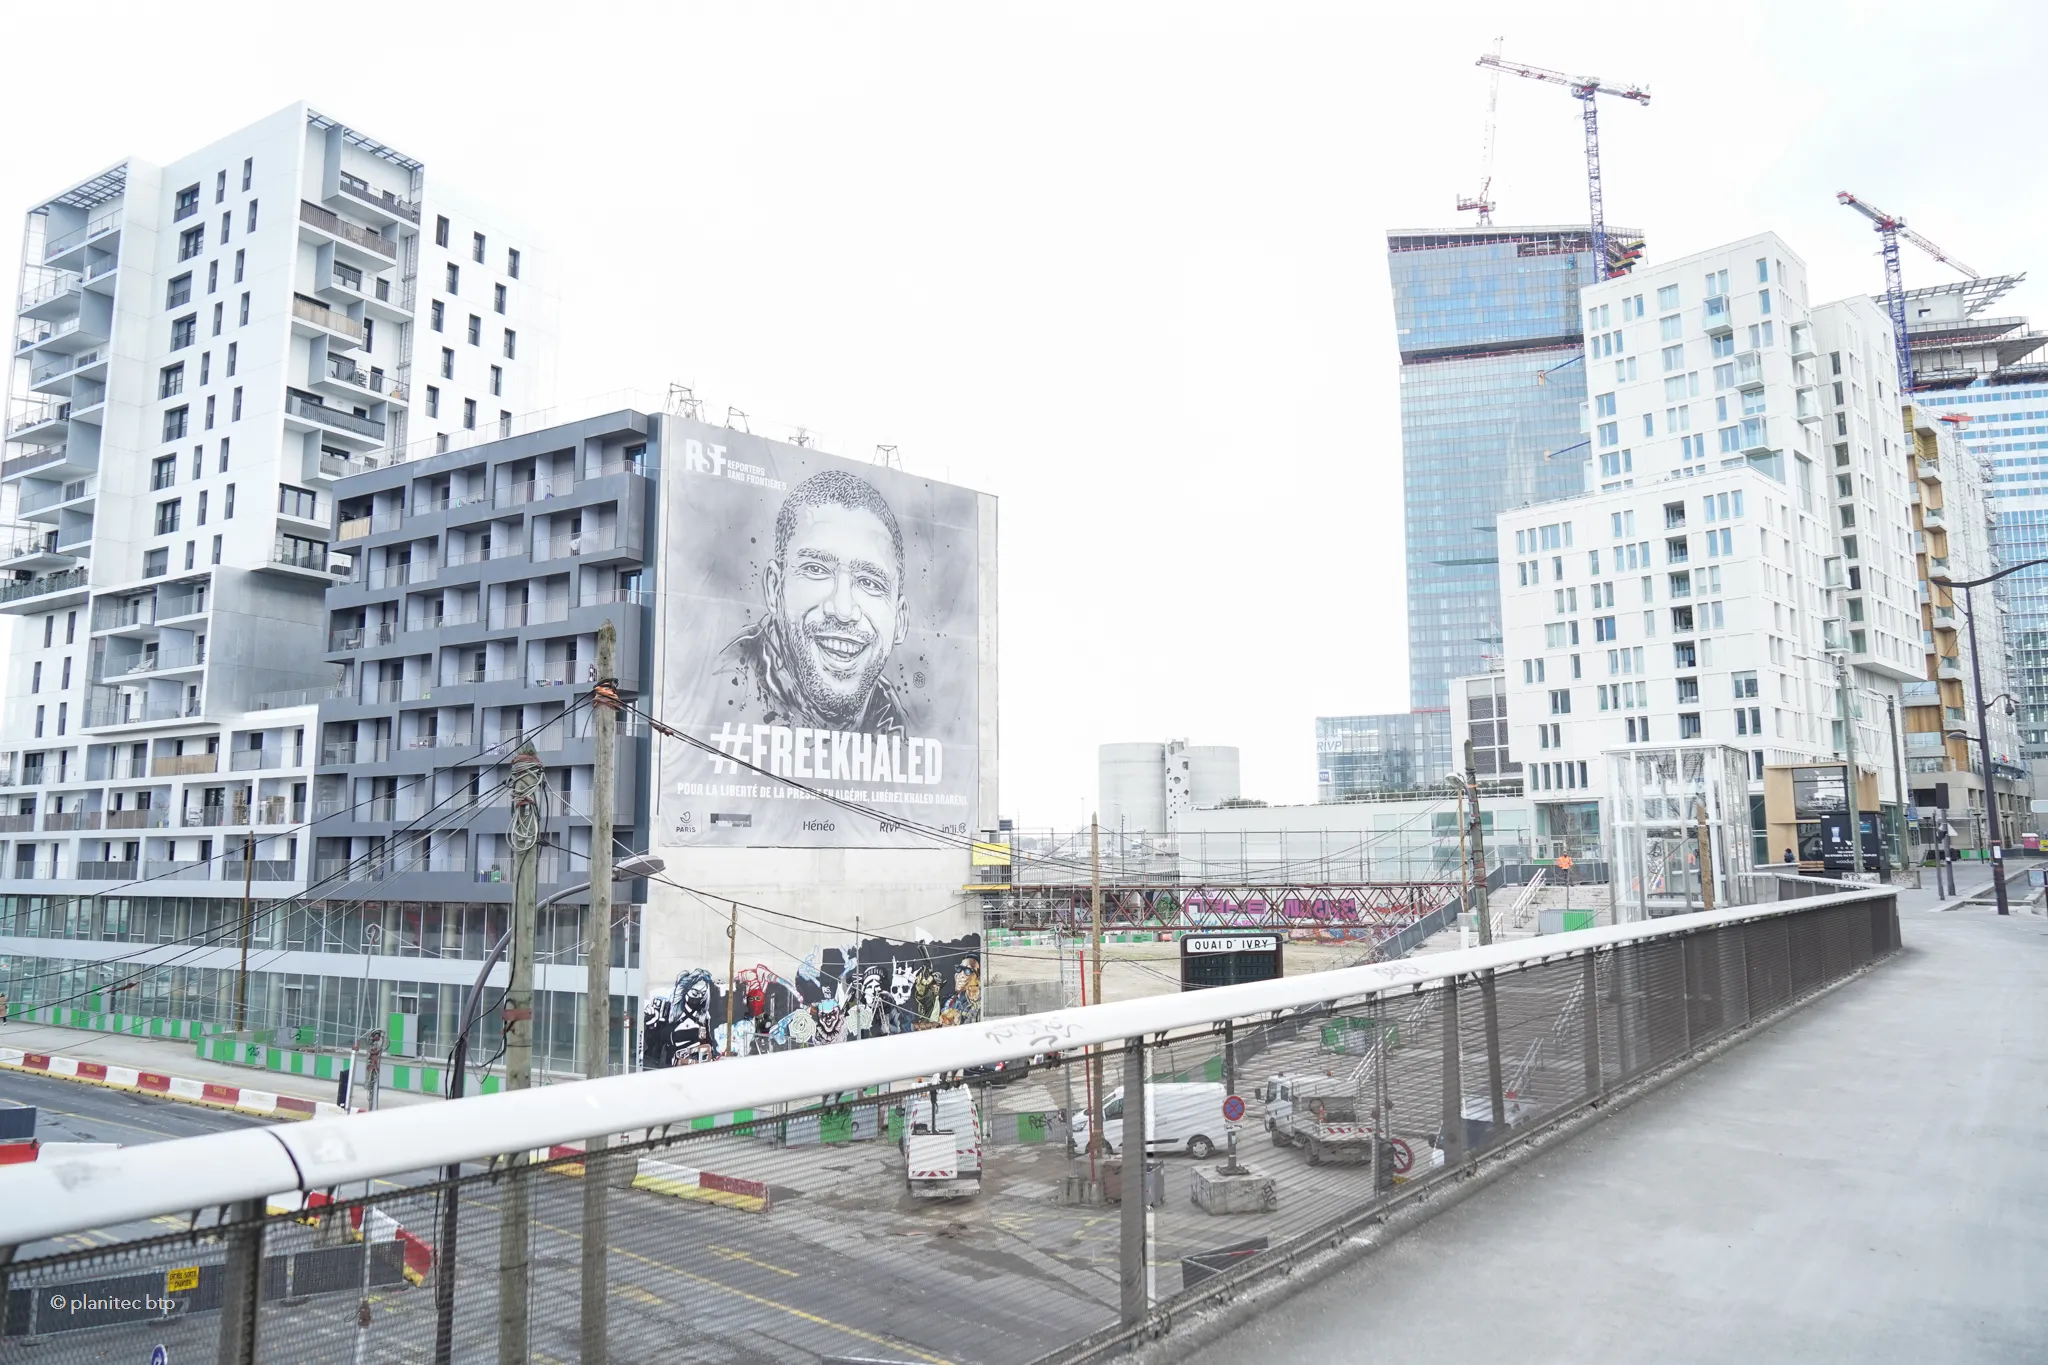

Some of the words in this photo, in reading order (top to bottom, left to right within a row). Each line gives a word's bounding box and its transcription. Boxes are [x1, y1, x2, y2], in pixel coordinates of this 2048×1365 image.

[685, 438, 727, 476] RSF
[727, 460, 765, 476] REPORTERS
[727, 470, 745, 481] SANS
[708, 722, 942, 785] #FREEKHALED
[677, 782, 704, 796] POUR
[705, 783, 718, 796] LA
[720, 783, 758, 798] LIBERTÉ
[760, 786, 772, 798] DE
[774, 786, 785, 799] LA
[835, 787, 870, 804] ALGÉRIE,
[871, 789, 903, 803] LIBÉREZ
[904, 792, 934, 804] KHALED
[802, 818, 836, 832] Hénéo
[879, 821, 901, 834] RIVP
[1194, 940, 1221, 950] QUAI
[1242, 939, 1268, 949] IVRY
